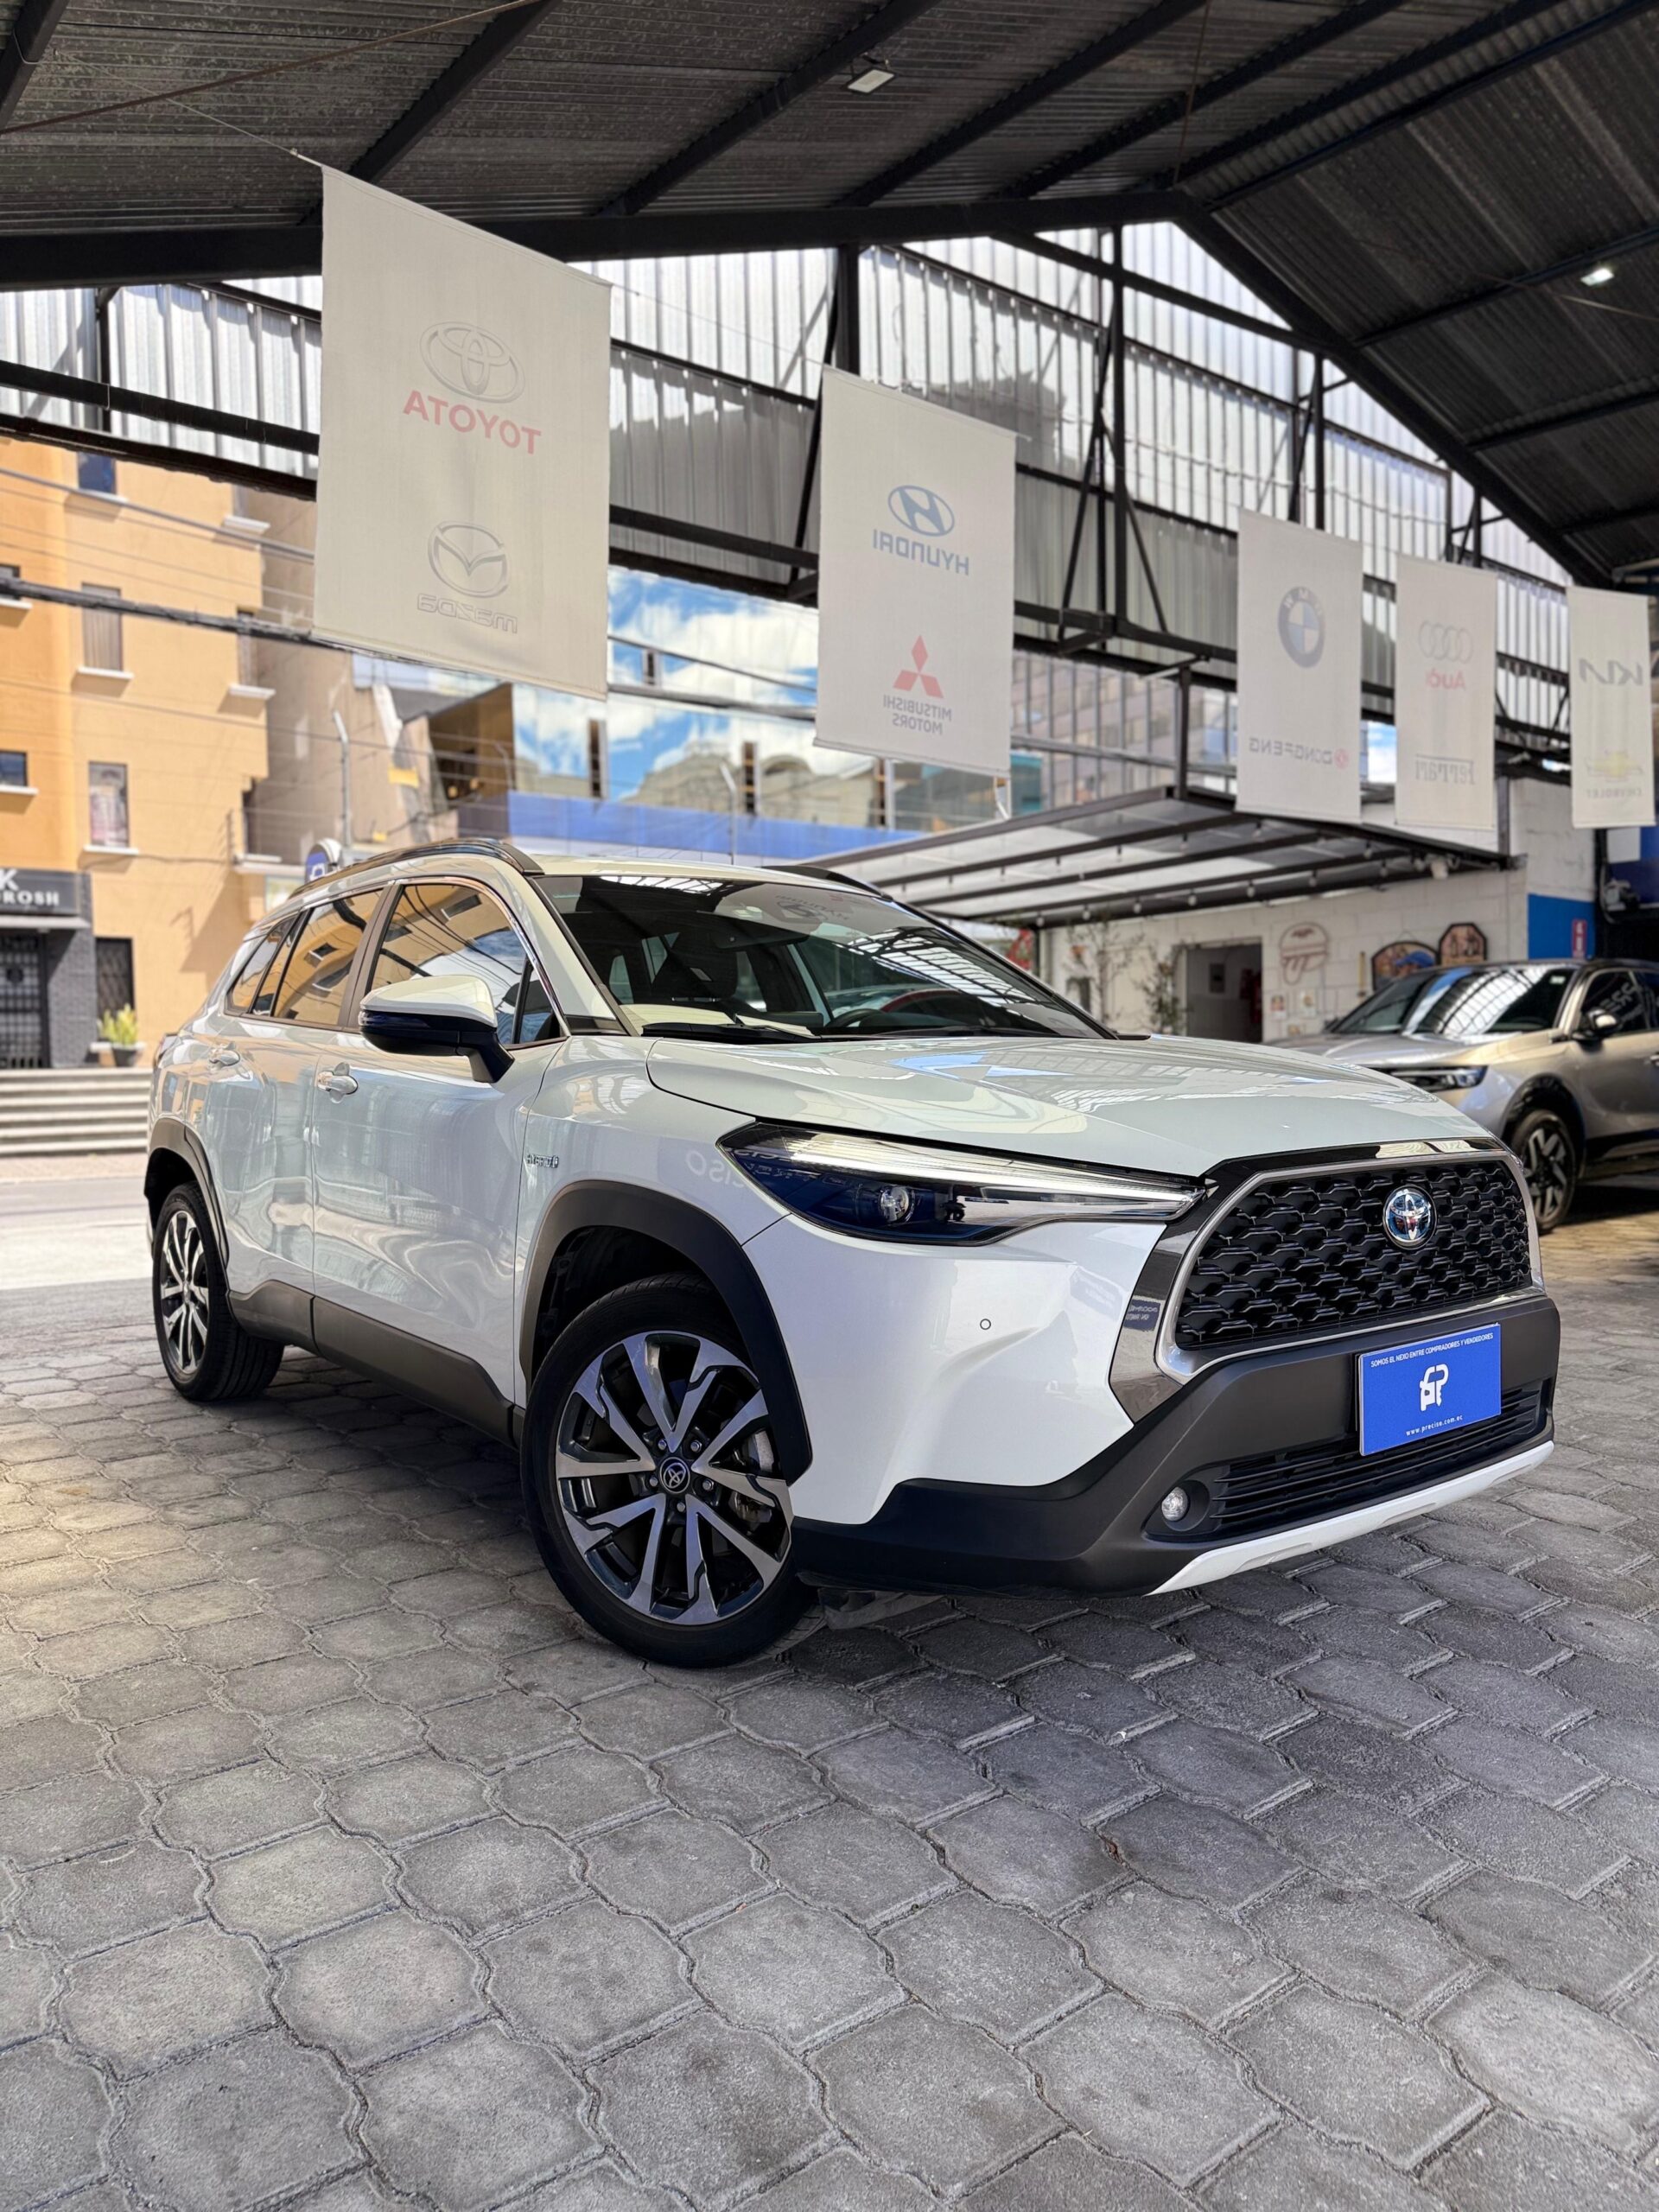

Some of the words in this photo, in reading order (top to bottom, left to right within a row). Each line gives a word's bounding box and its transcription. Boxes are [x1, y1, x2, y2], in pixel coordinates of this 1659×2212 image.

[1370, 1357, 1389, 1368] SOMOS
[1396, 1353, 1409, 1363] NEXO
[1409, 1349, 1425, 1358] ENTRE
[1425, 1341, 1460, 1355] COMPRADORES
[1464, 1332, 1493, 1345] VENDEDORES
